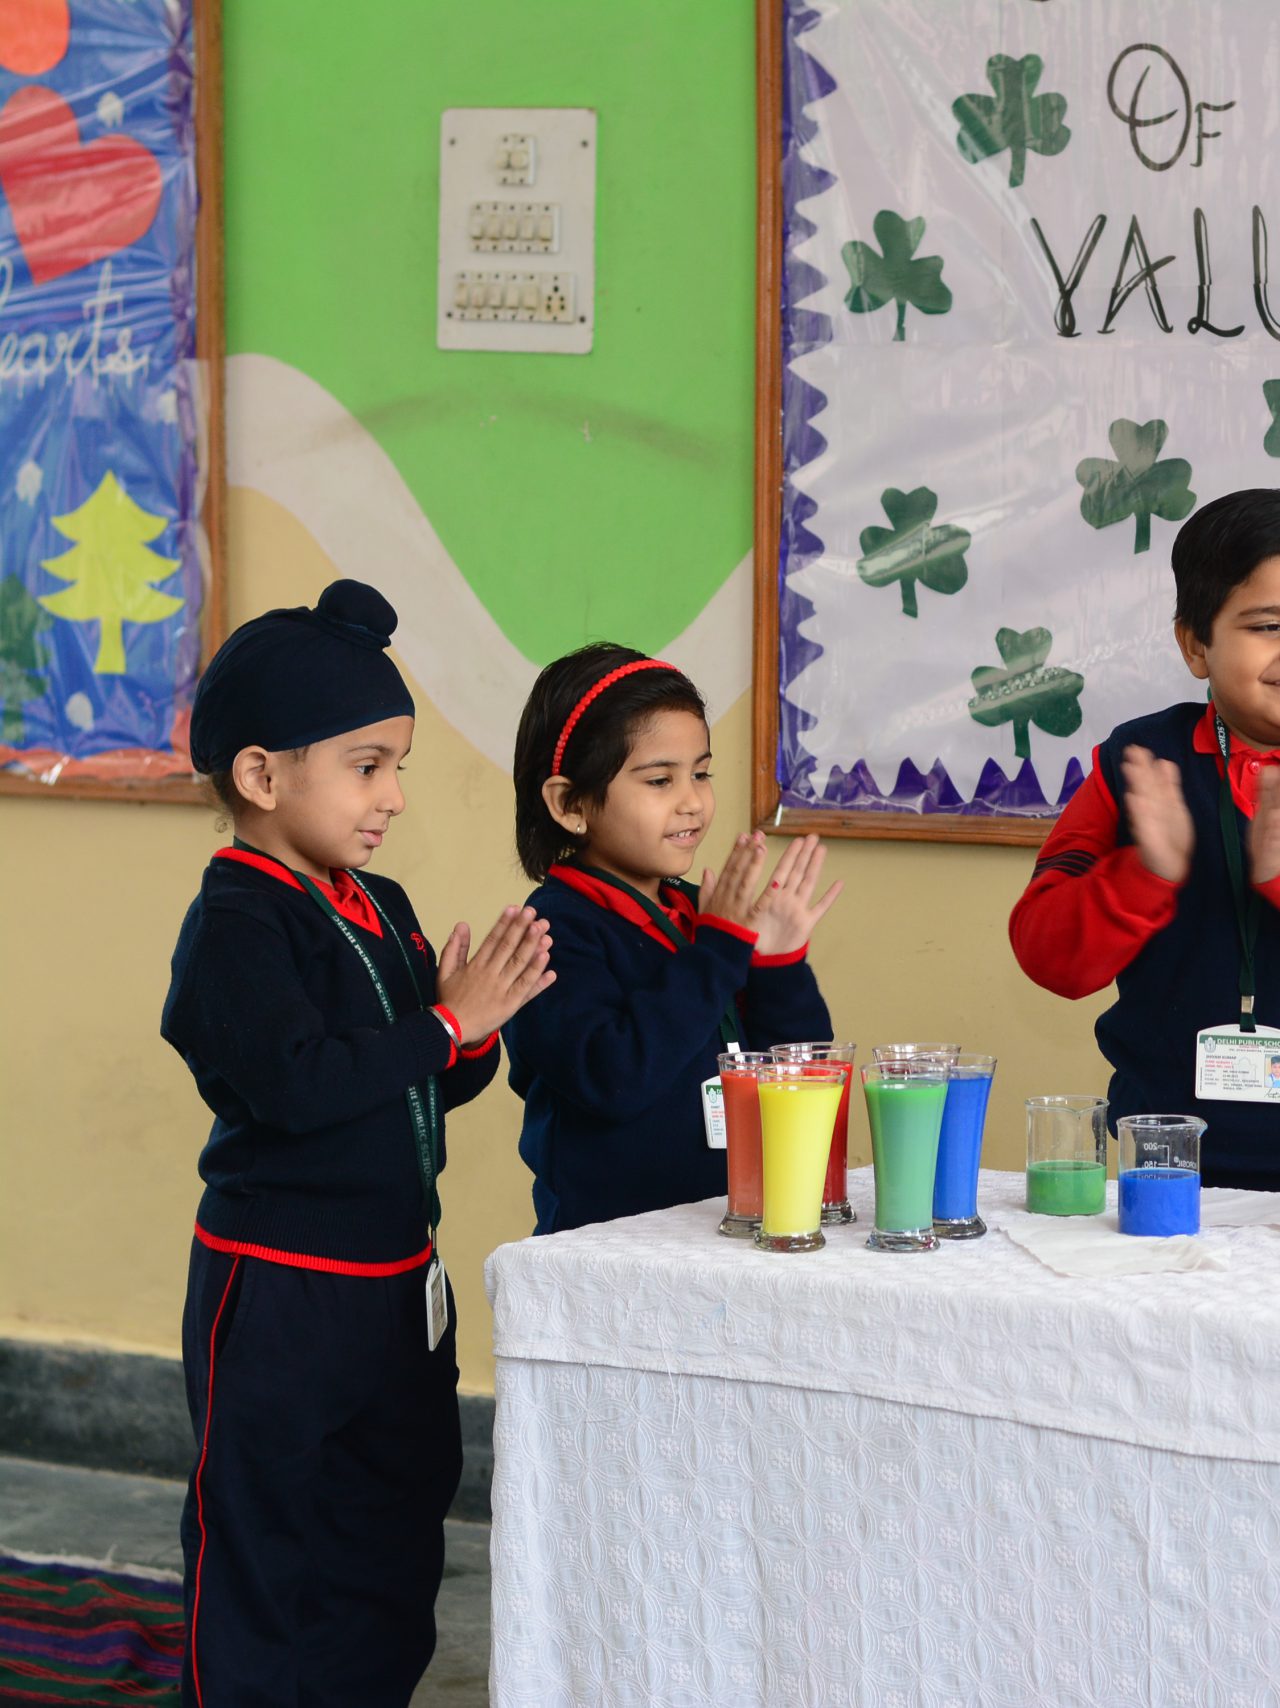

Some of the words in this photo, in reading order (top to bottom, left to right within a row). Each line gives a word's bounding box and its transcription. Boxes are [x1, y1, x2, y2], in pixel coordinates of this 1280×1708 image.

[331, 914, 356, 944] DELHI
[353, 942, 378, 981] PUBLIC
[375, 981, 394, 1025] SCHOO
